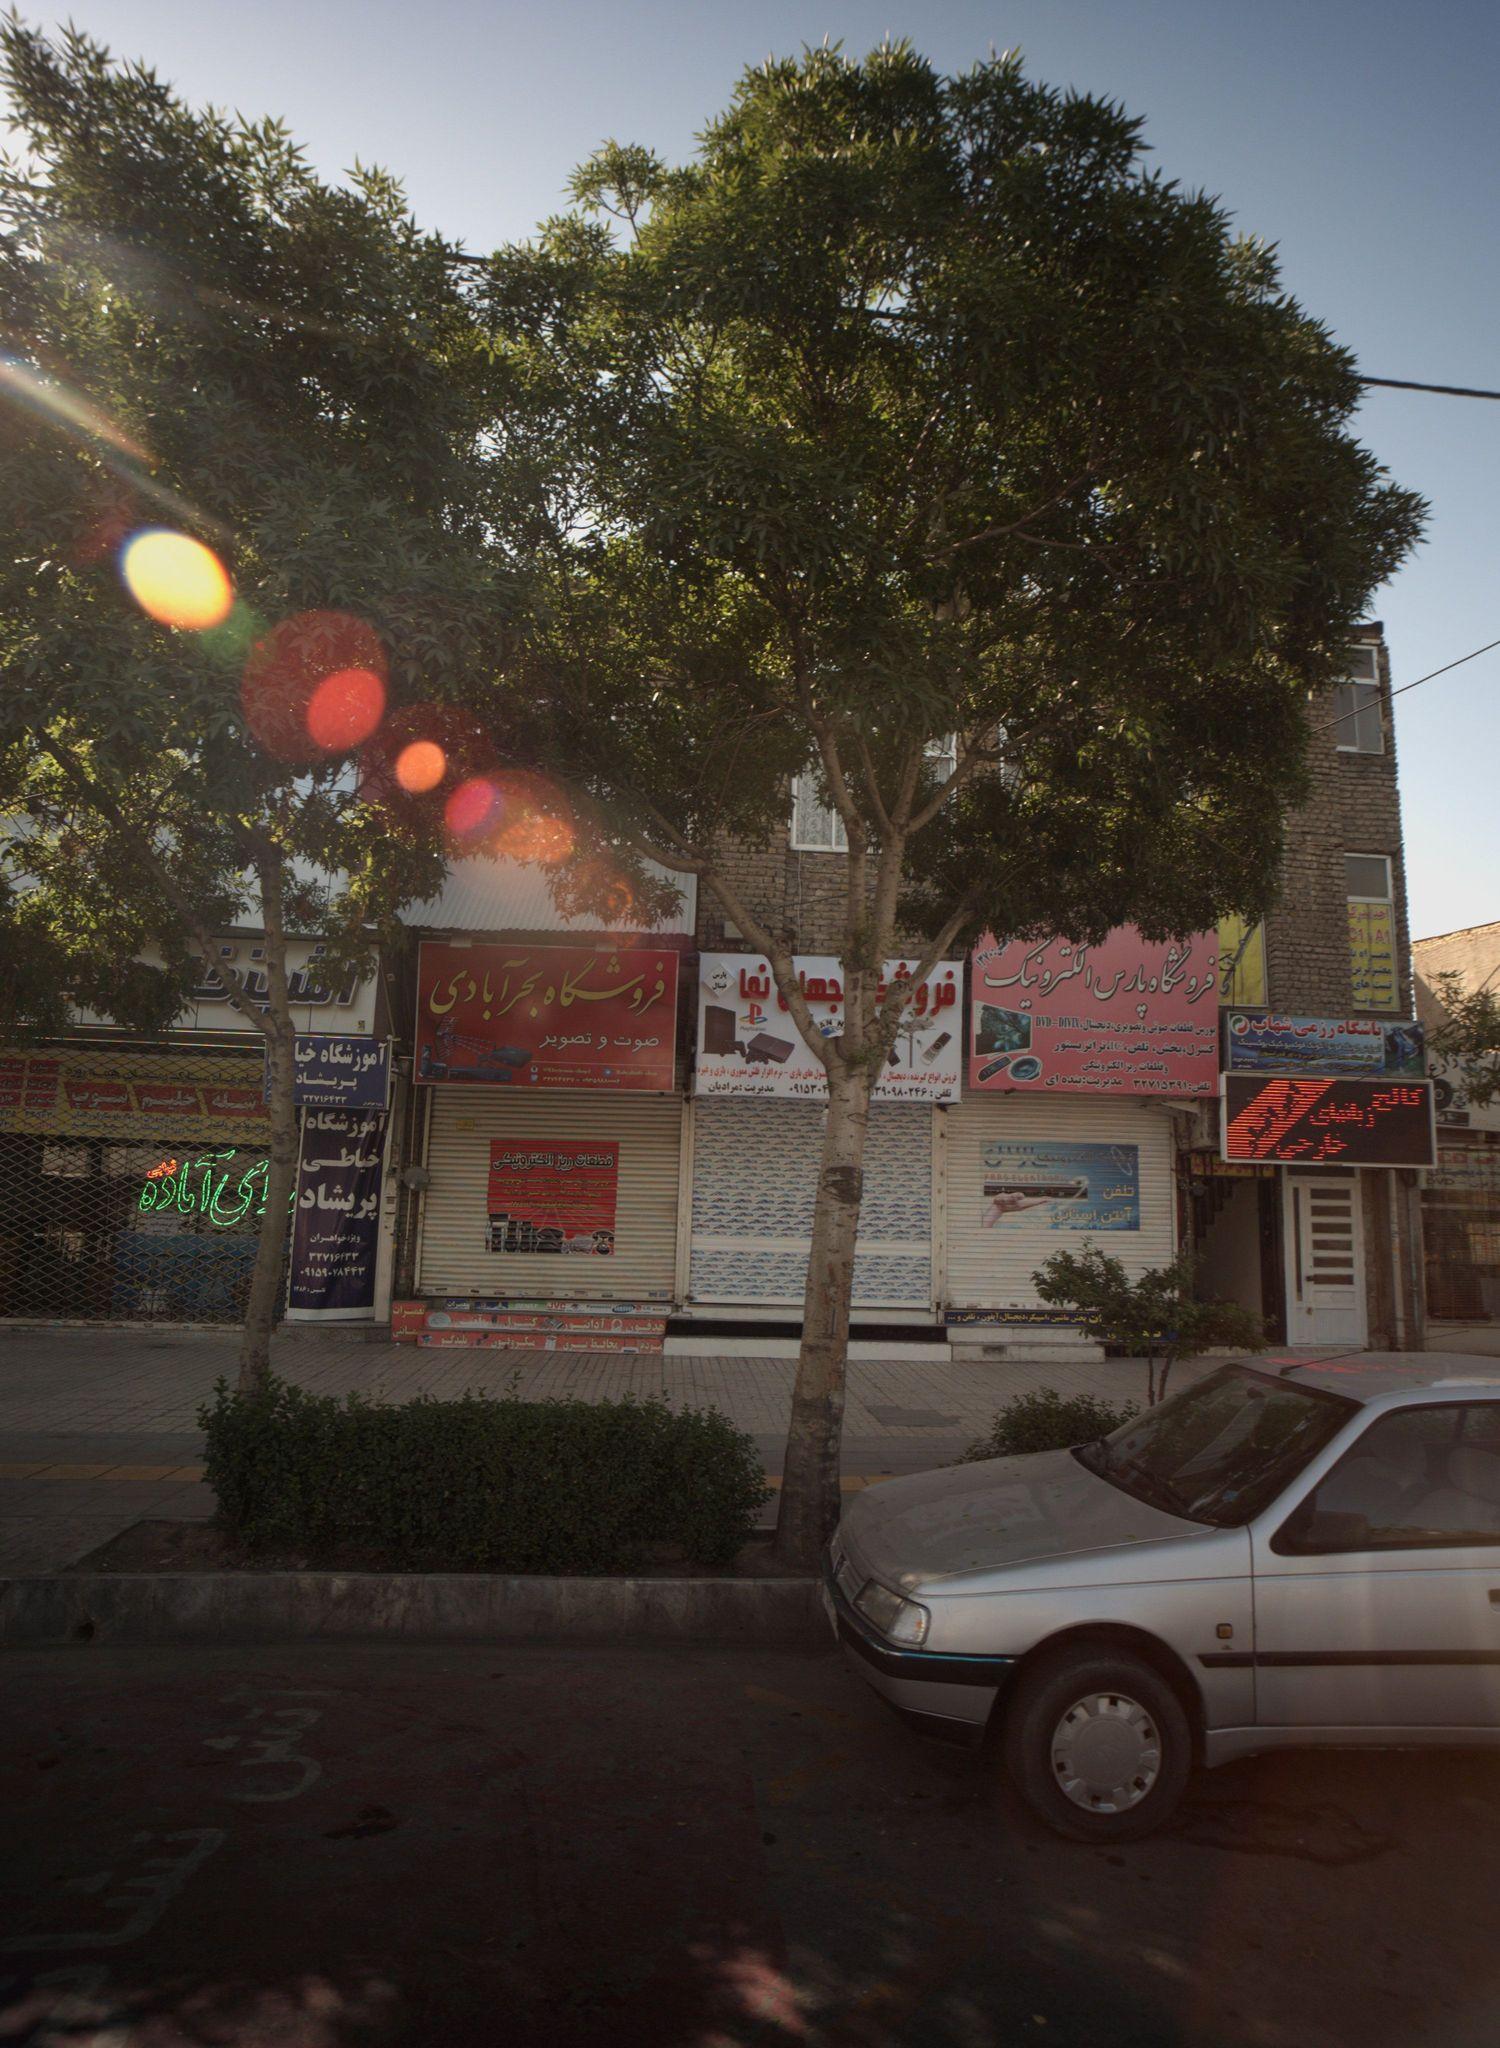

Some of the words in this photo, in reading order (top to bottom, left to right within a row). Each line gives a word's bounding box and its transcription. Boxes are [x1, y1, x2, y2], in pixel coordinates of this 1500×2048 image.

[739, 963, 770, 999] نما
[984, 934, 1091, 1010] الکترونیک
[1147, 946, 1216, 1003] فروشگاه
[544, 956, 666, 1017] فروشگاه
[1094, 963, 1147, 1018] پارس
[1148, 1023, 1169, 1034] صوتی
[1170, 1022, 1194, 1033] قطعات
[1251, 1014, 1294, 1037] شهاب
[1294, 1020, 1336, 1040] رزمی
[1336, 1020, 1382, 1040] باشگاه
[538, 1032, 593, 1050] تصویر
[597, 1034, 608, 1050] و
[612, 1035, 660, 1052] صوت
[320, 1042, 387, 1072] آموزشگاه
[1080, 1060, 1124, 1072] الکترونیکی
[296, 1072, 357, 1091] پریشاد
[1372, 1088, 1424, 1112] کالج
[305, 1111, 386, 1138] آموزشگاه
[301, 1146, 380, 1173] خیاطی
[575, 1152, 614, 1169] قطعات
[299, 1182, 377, 1220] پریشاد
[1102, 1184, 1136, 1200] تلفن
